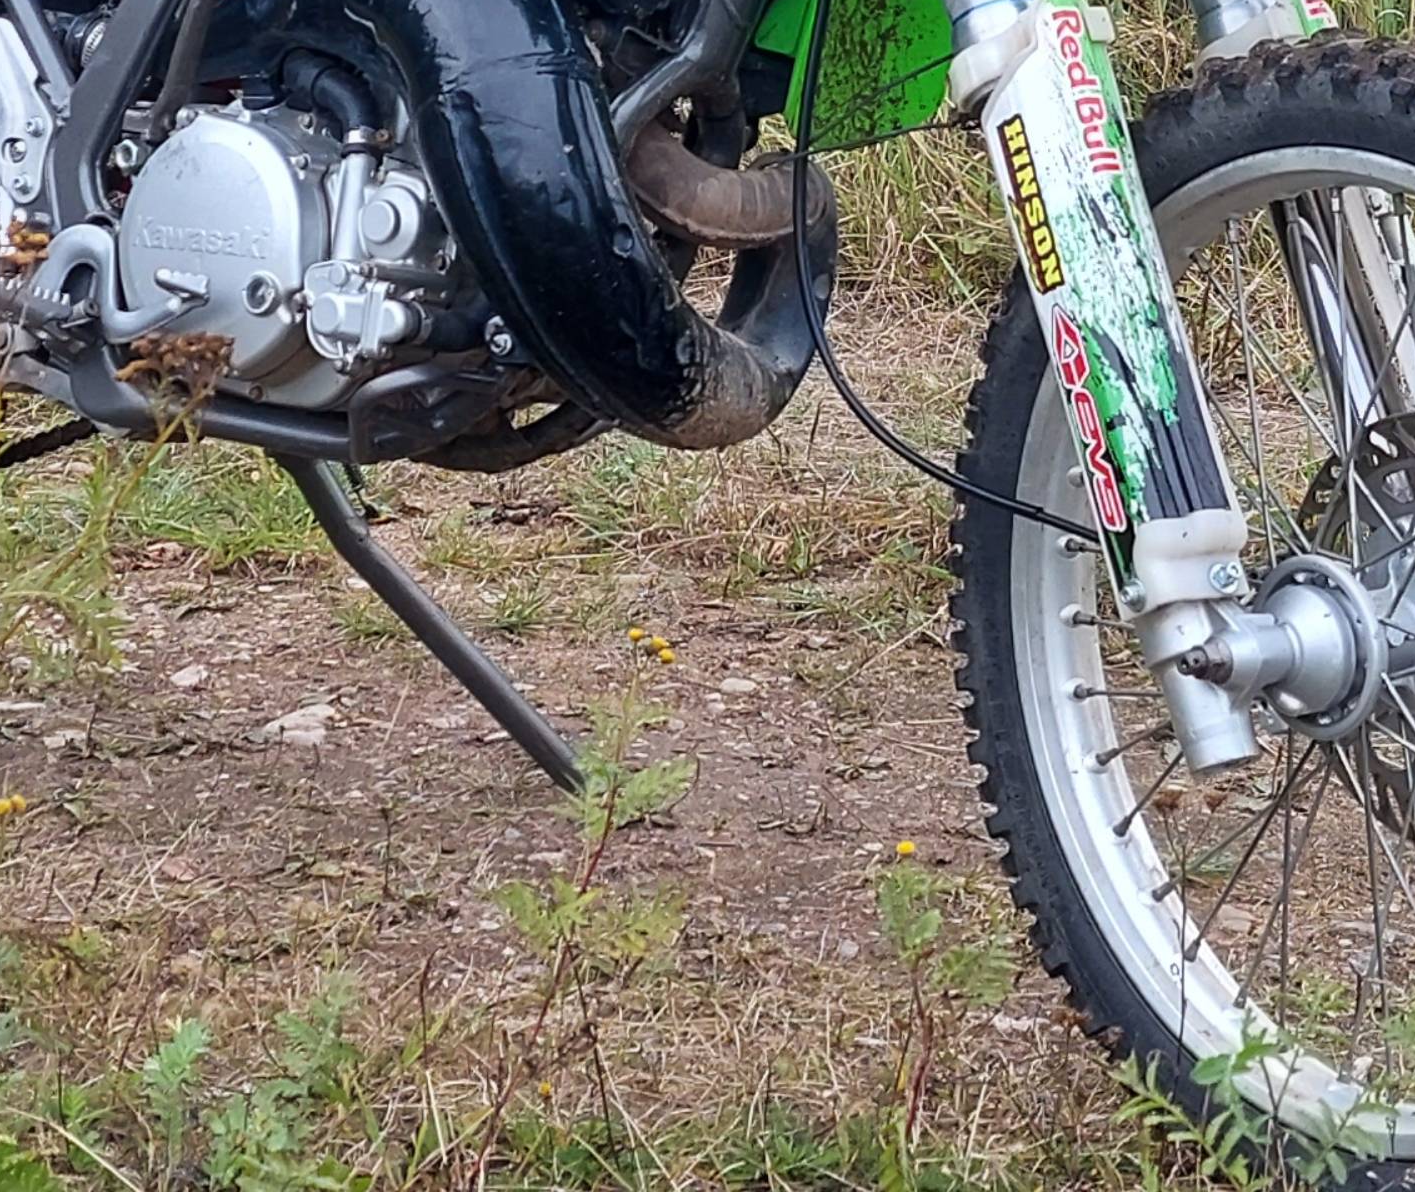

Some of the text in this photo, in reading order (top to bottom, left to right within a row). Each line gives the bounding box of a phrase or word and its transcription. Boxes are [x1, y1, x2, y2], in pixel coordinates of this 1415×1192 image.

[1052, 10, 1121, 173] Red Bull
[1003, 117, 1063, 289] HINSON
[1072, 389, 1127, 532] EVS
